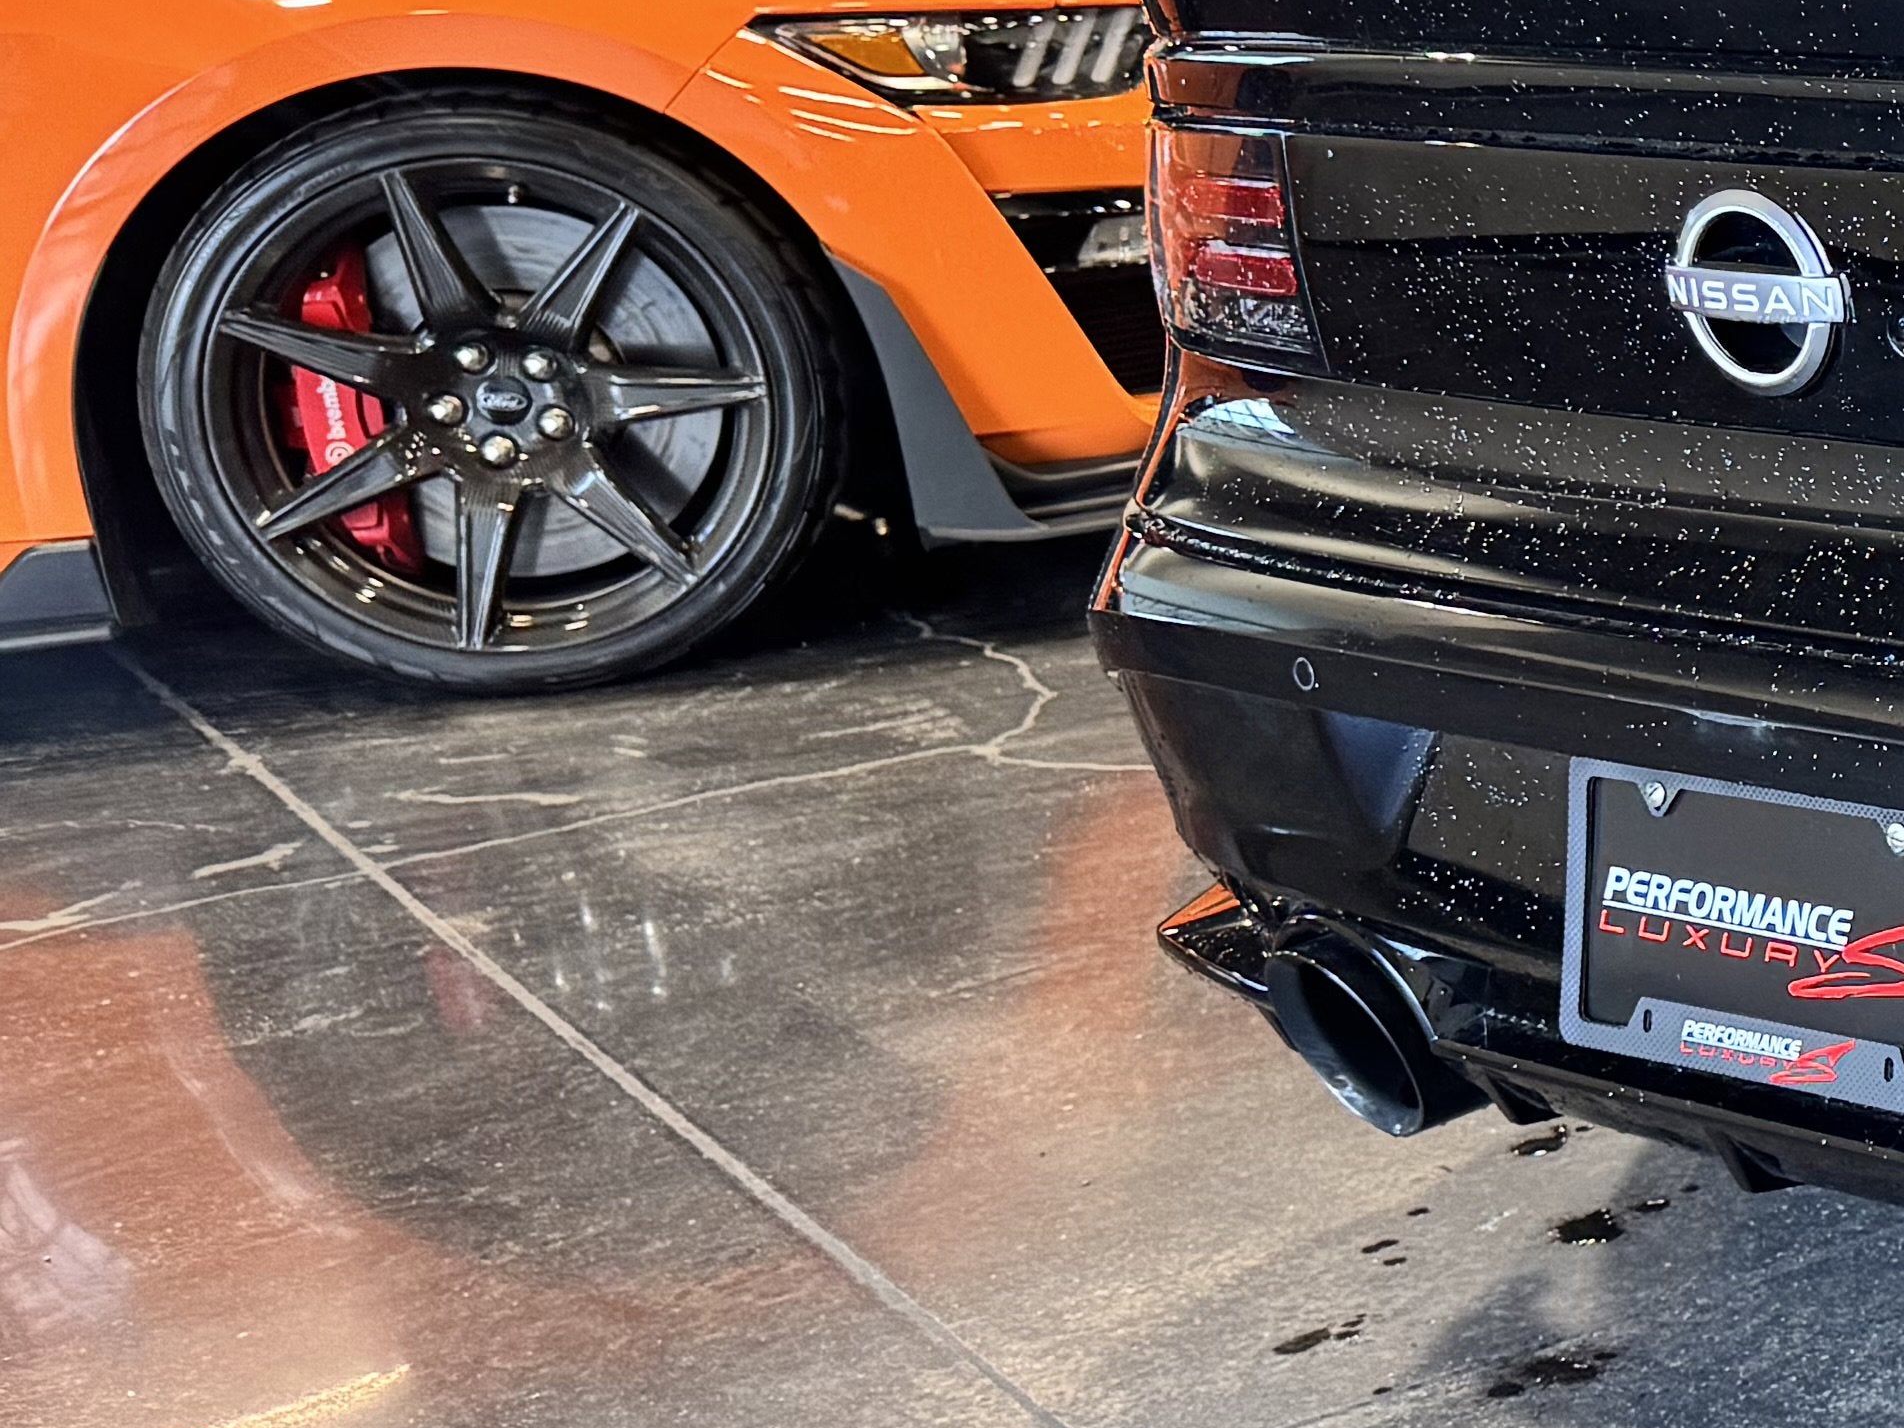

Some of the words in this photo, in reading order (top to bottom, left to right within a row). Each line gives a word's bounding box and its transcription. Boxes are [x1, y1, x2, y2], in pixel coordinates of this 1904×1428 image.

[1667, 274, 1835, 317] NISSAN
[316, 375, 346, 440] bremb
[1603, 866, 1855, 944] PERFORMANCE
[1598, 909, 1841, 973] LUXURY
[1679, 1040, 1795, 1070] LUXURY
[1681, 1019, 1803, 1057] PERFORMANCE
